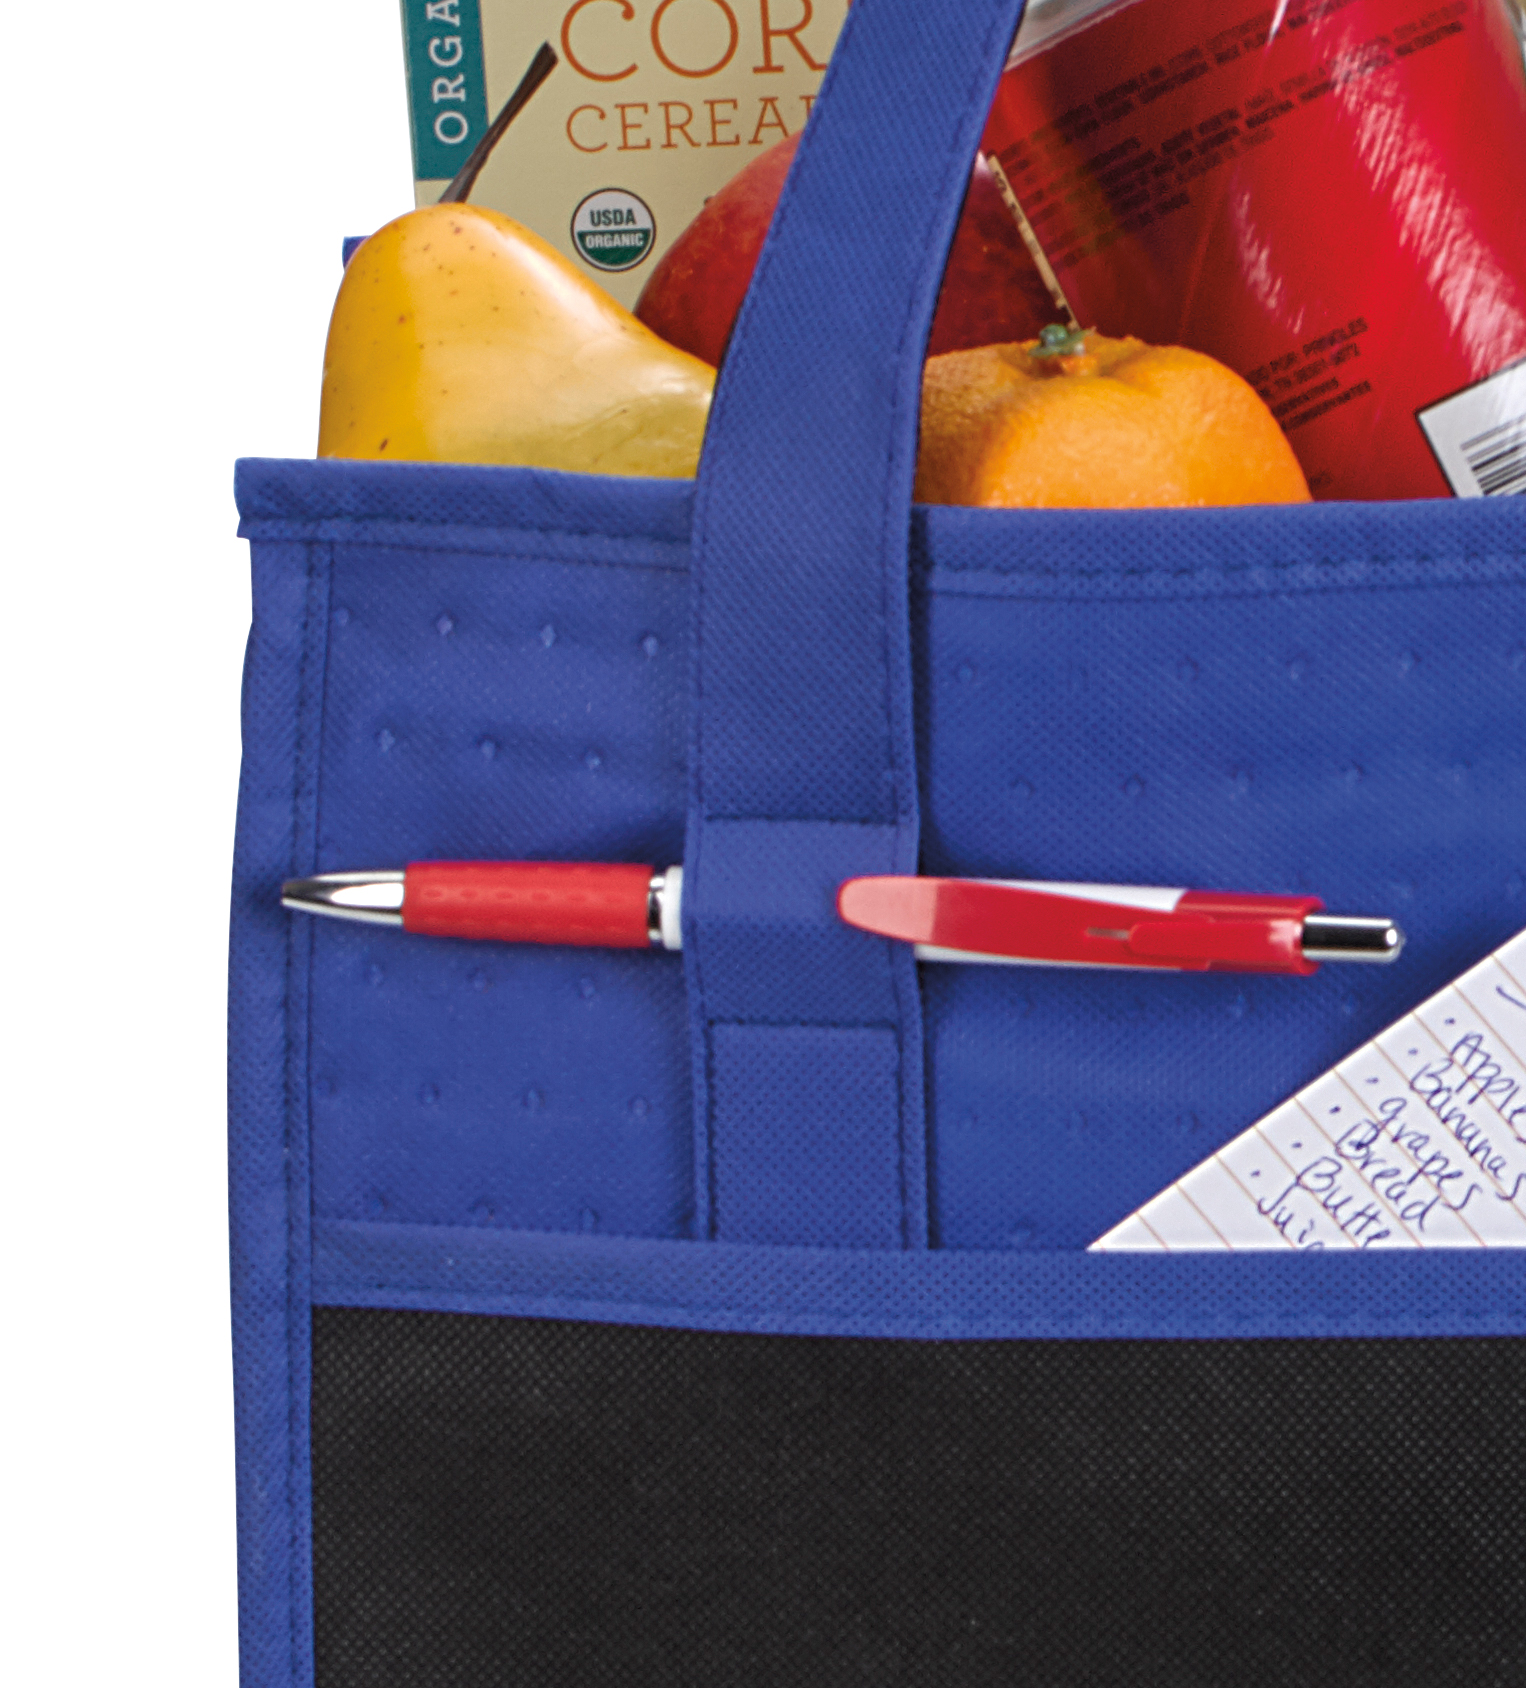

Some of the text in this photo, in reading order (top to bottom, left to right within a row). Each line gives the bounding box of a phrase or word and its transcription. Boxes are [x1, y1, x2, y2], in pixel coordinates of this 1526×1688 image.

[589, 208, 637, 227] USDA
[585, 231, 644, 249] ORGANIC
[1335, 1119, 1440, 1232] Bread
